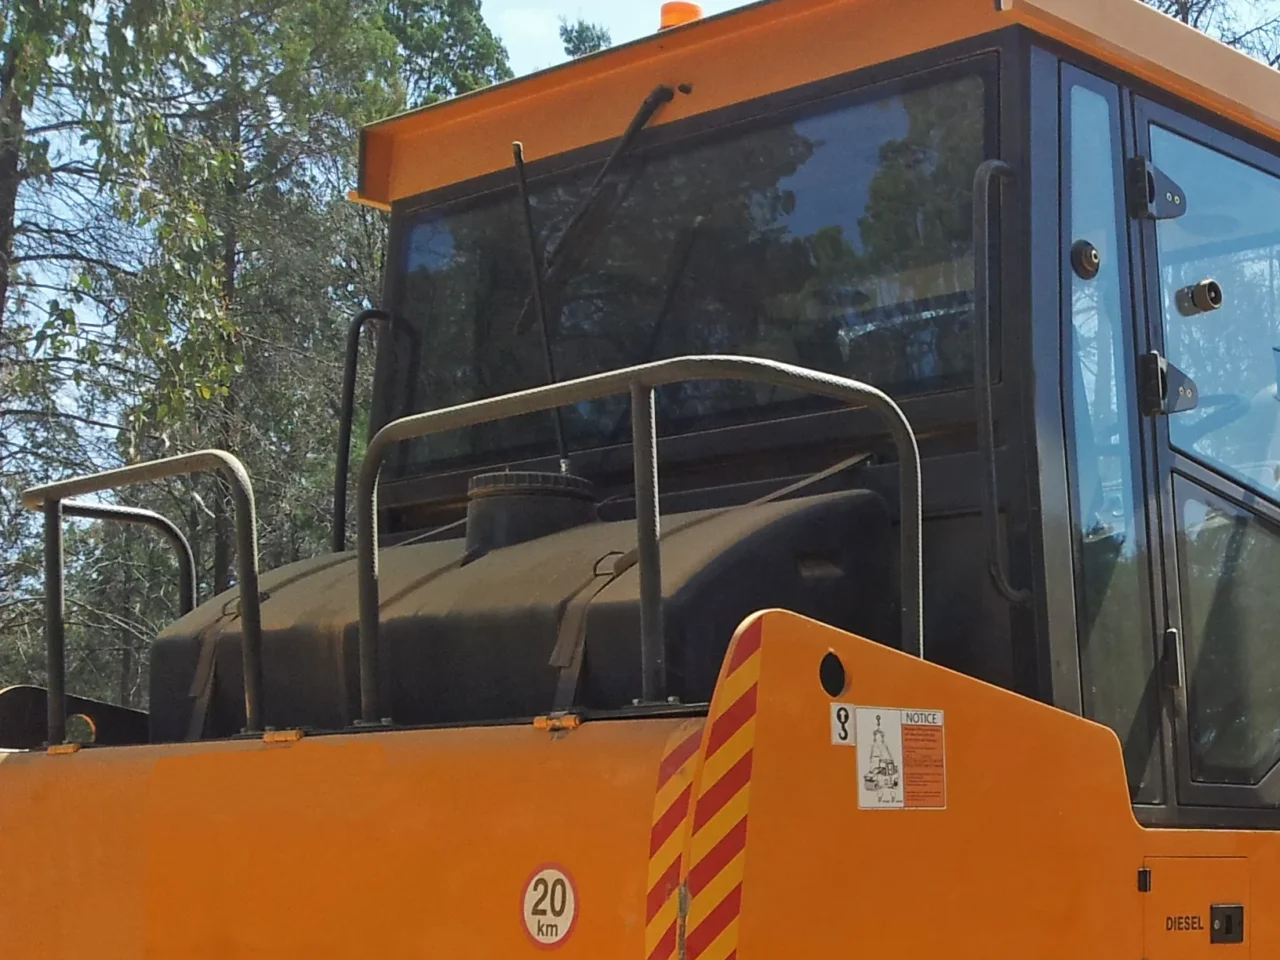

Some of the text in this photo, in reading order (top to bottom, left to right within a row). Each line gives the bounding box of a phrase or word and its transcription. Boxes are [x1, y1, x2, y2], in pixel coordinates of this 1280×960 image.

[906, 712, 937, 724] NOTICE
[531, 877, 567, 917] 20
[537, 919, 558, 937] km
[1165, 916, 1204, 931] DIESEL
